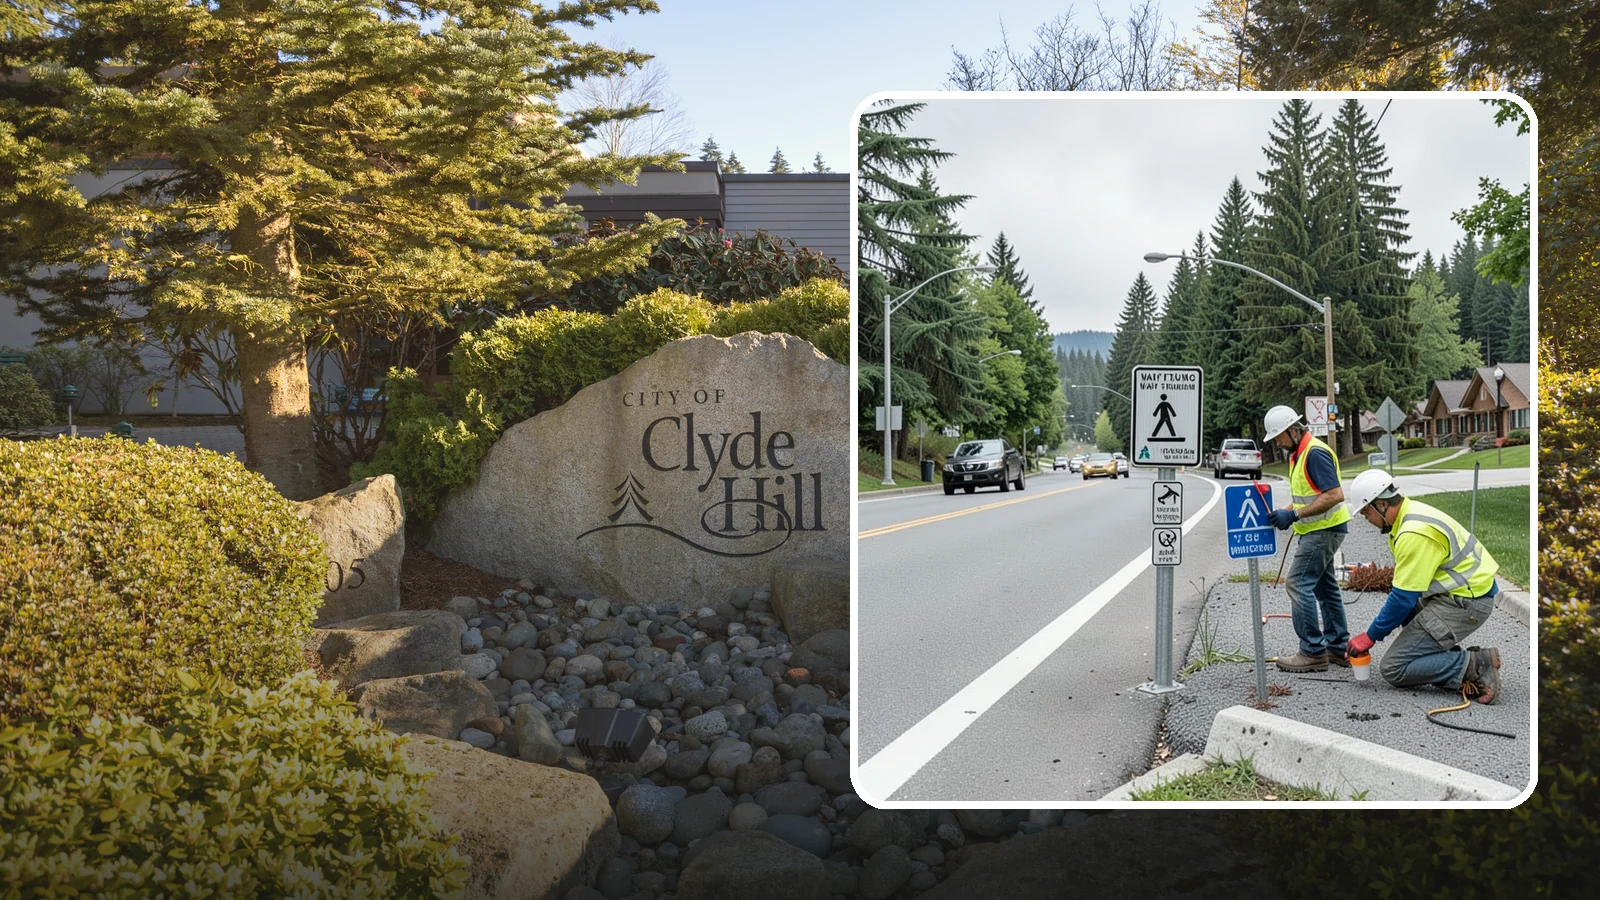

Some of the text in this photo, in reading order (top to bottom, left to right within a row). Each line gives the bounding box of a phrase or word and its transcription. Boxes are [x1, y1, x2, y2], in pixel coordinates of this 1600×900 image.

[622, 389, 725, 407] CITY OF
[642, 411, 795, 492] Clyde
[719, 472, 828, 532] Hill
